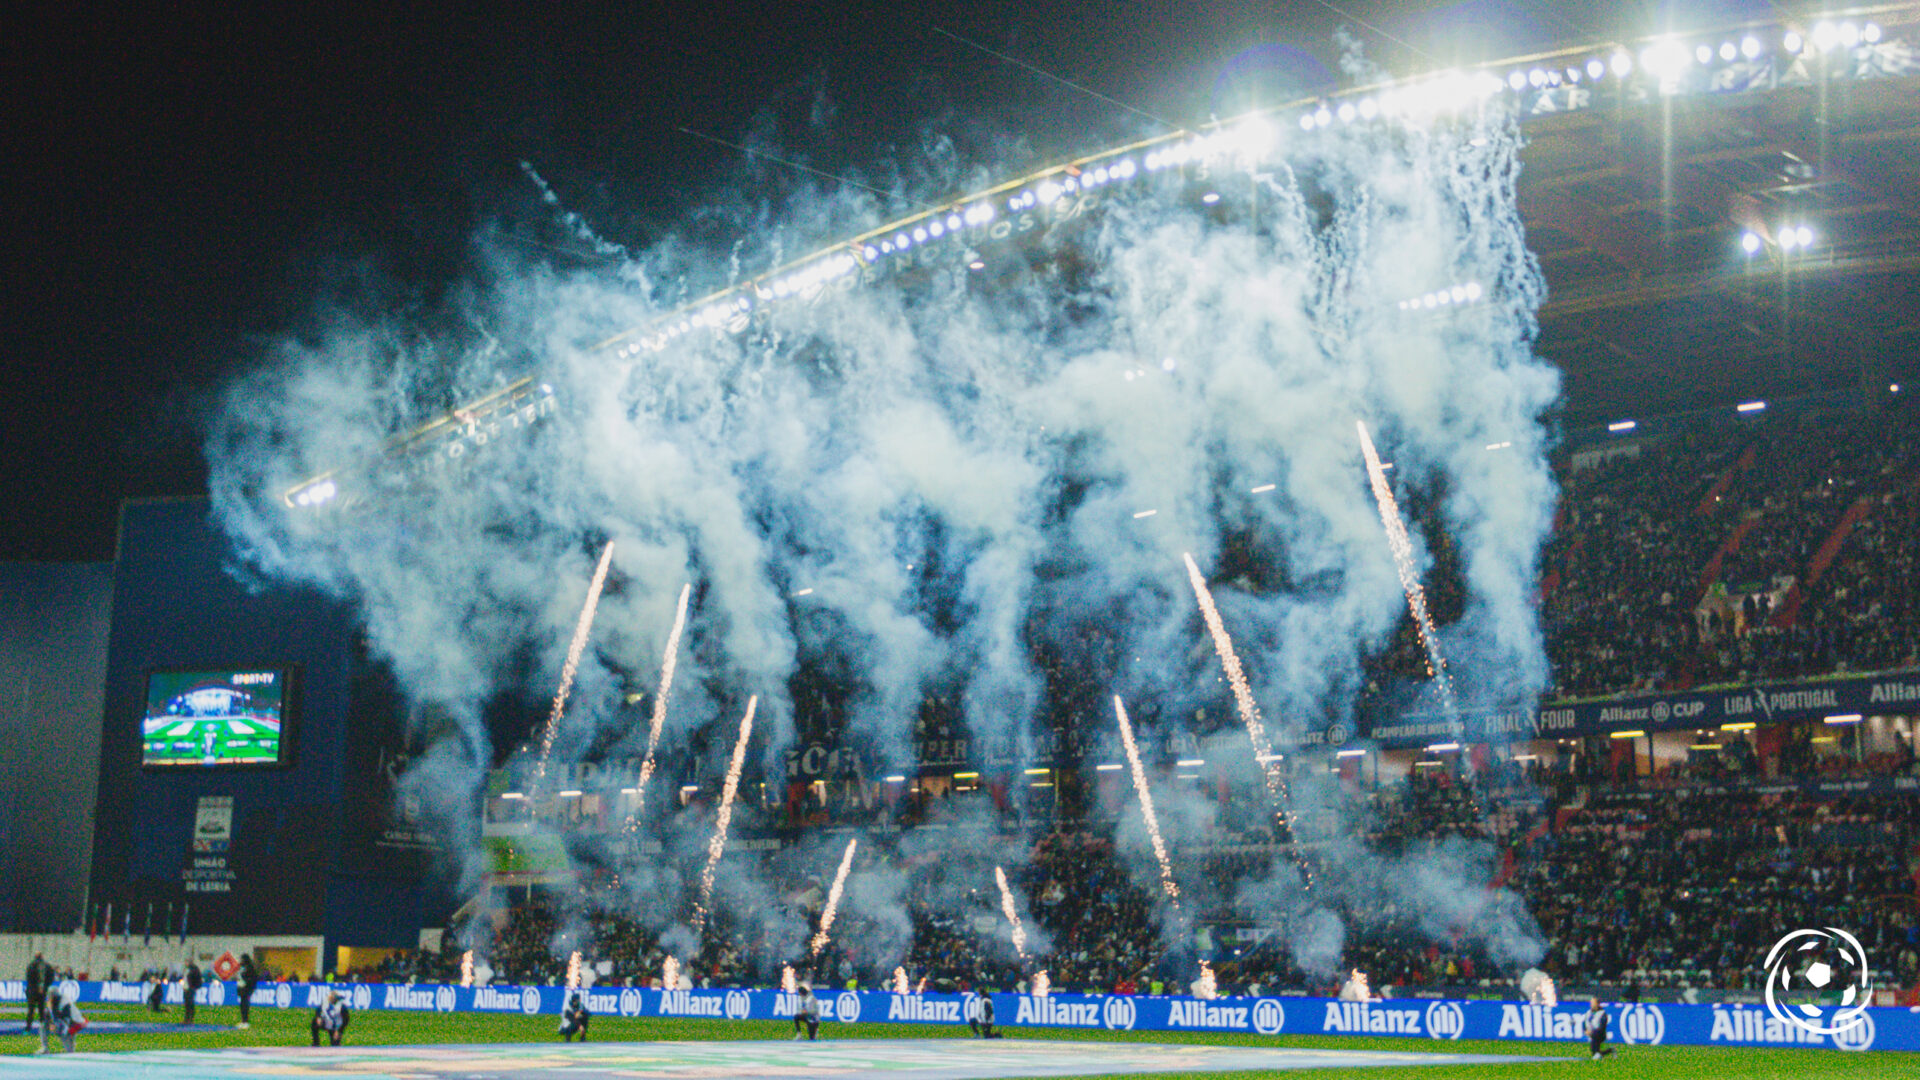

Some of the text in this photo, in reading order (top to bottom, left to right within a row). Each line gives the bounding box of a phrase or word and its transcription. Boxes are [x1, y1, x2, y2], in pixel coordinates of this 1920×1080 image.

[1724, 689, 1838, 715] LIGA PORTUGAL
[1869, 682, 1920, 703] Allia
[1485, 709, 1575, 733] FINAL FOUR
[1600, 701, 1705, 722] Allianz CUP
[100, 981, 141, 1001] Allianz
[384, 986, 434, 1008] Allianz
[473, 988, 521, 1010] Allianz
[659, 990, 722, 1016] Allianz
[888, 995, 960, 1021] Allianz
[1016, 996, 1099, 1025] Allianz
[1168, 1000, 1248, 1028] Allianz
[1323, 1001, 1421, 1033] Allianz
[1710, 1009, 1825, 1043] Allianz
